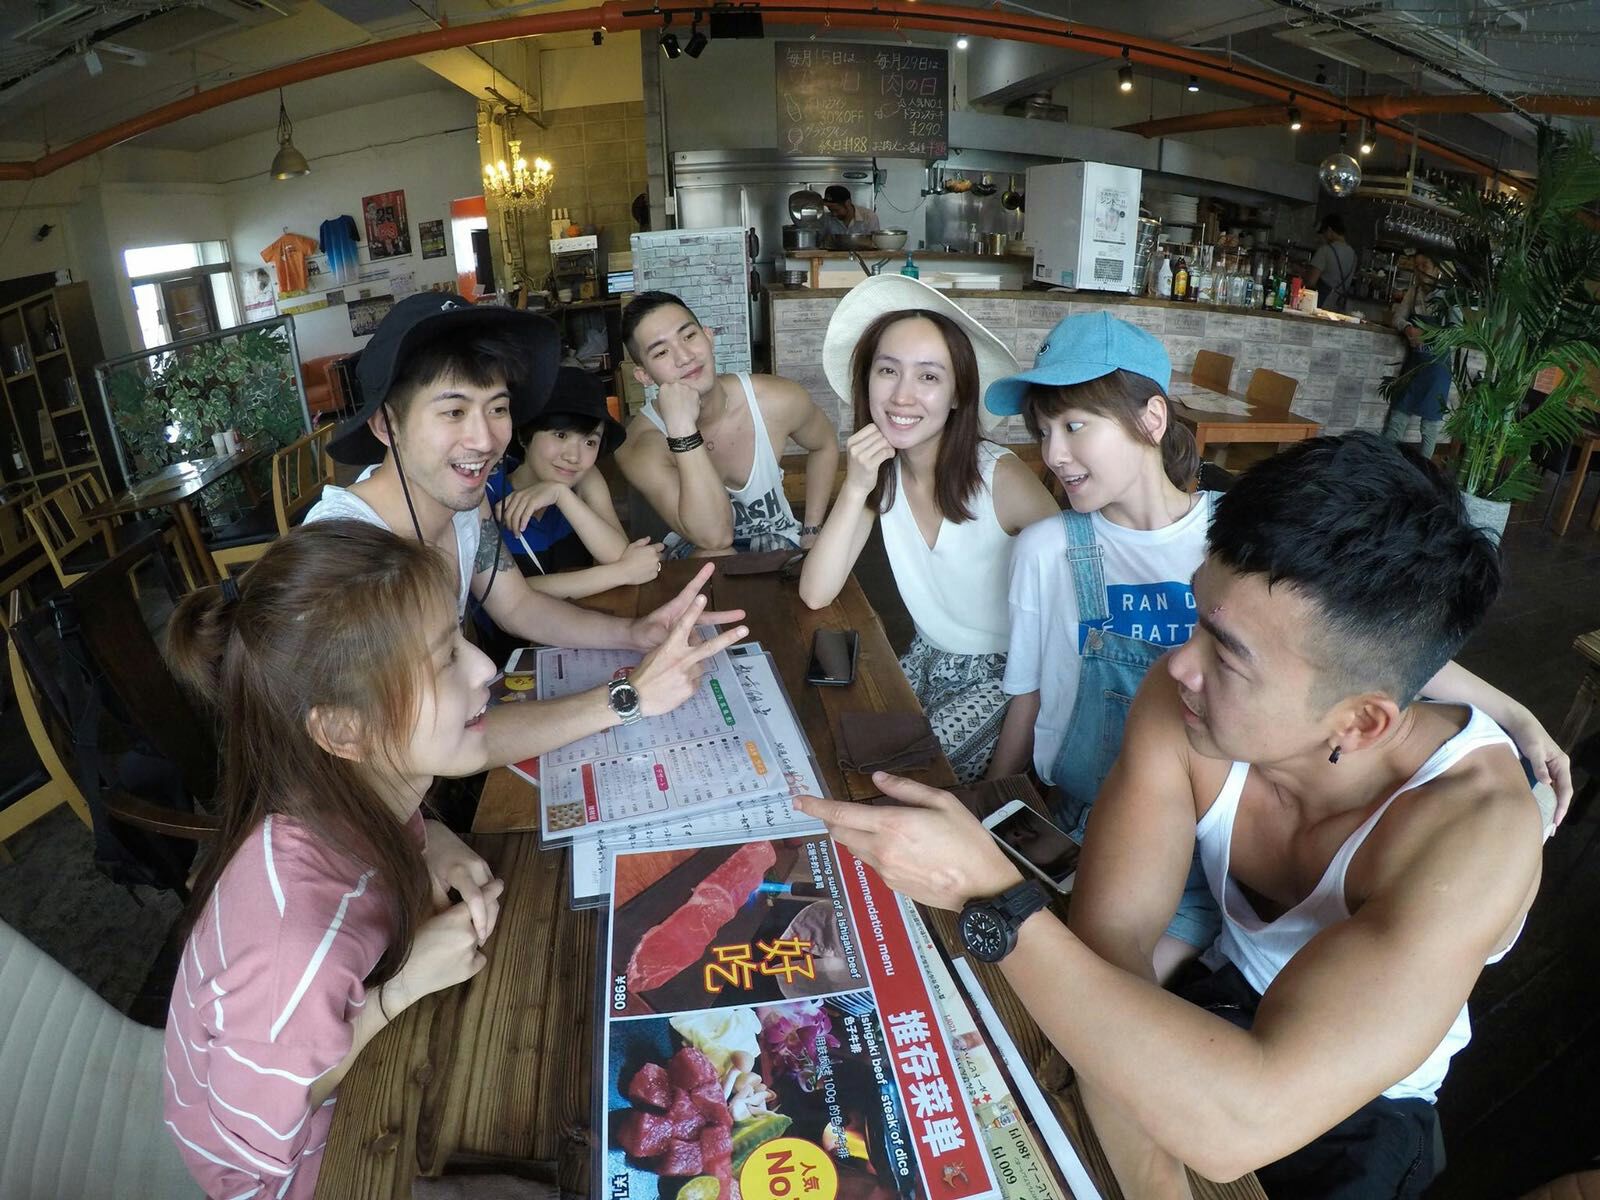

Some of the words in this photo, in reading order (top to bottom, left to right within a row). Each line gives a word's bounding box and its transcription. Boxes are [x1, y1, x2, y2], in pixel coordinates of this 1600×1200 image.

[1122, 592, 1168, 611] RAN
[819, 839, 833, 875] Warming
[827, 876, 841, 902] sushi
[833, 900, 844, 910] of
[853, 854, 885, 943] ecommendation
[877, 942, 895, 977] menu
[838, 917, 856, 957] Ishigaki
[704, 936, 817, 994] 好吃
[847, 954, 862, 979] beef
[614, 974, 627, 1011] ¥980
[860, 1012, 881, 1058] Ishigaki
[871, 1057, 888, 1087] beef
[823, 1077, 836, 1104] 100g
[880, 1093, 899, 1130] steak
[889, 1129, 905, 1147] of
[799, 1160, 820, 1193] 人気
[894, 1146, 910, 1177] dice
